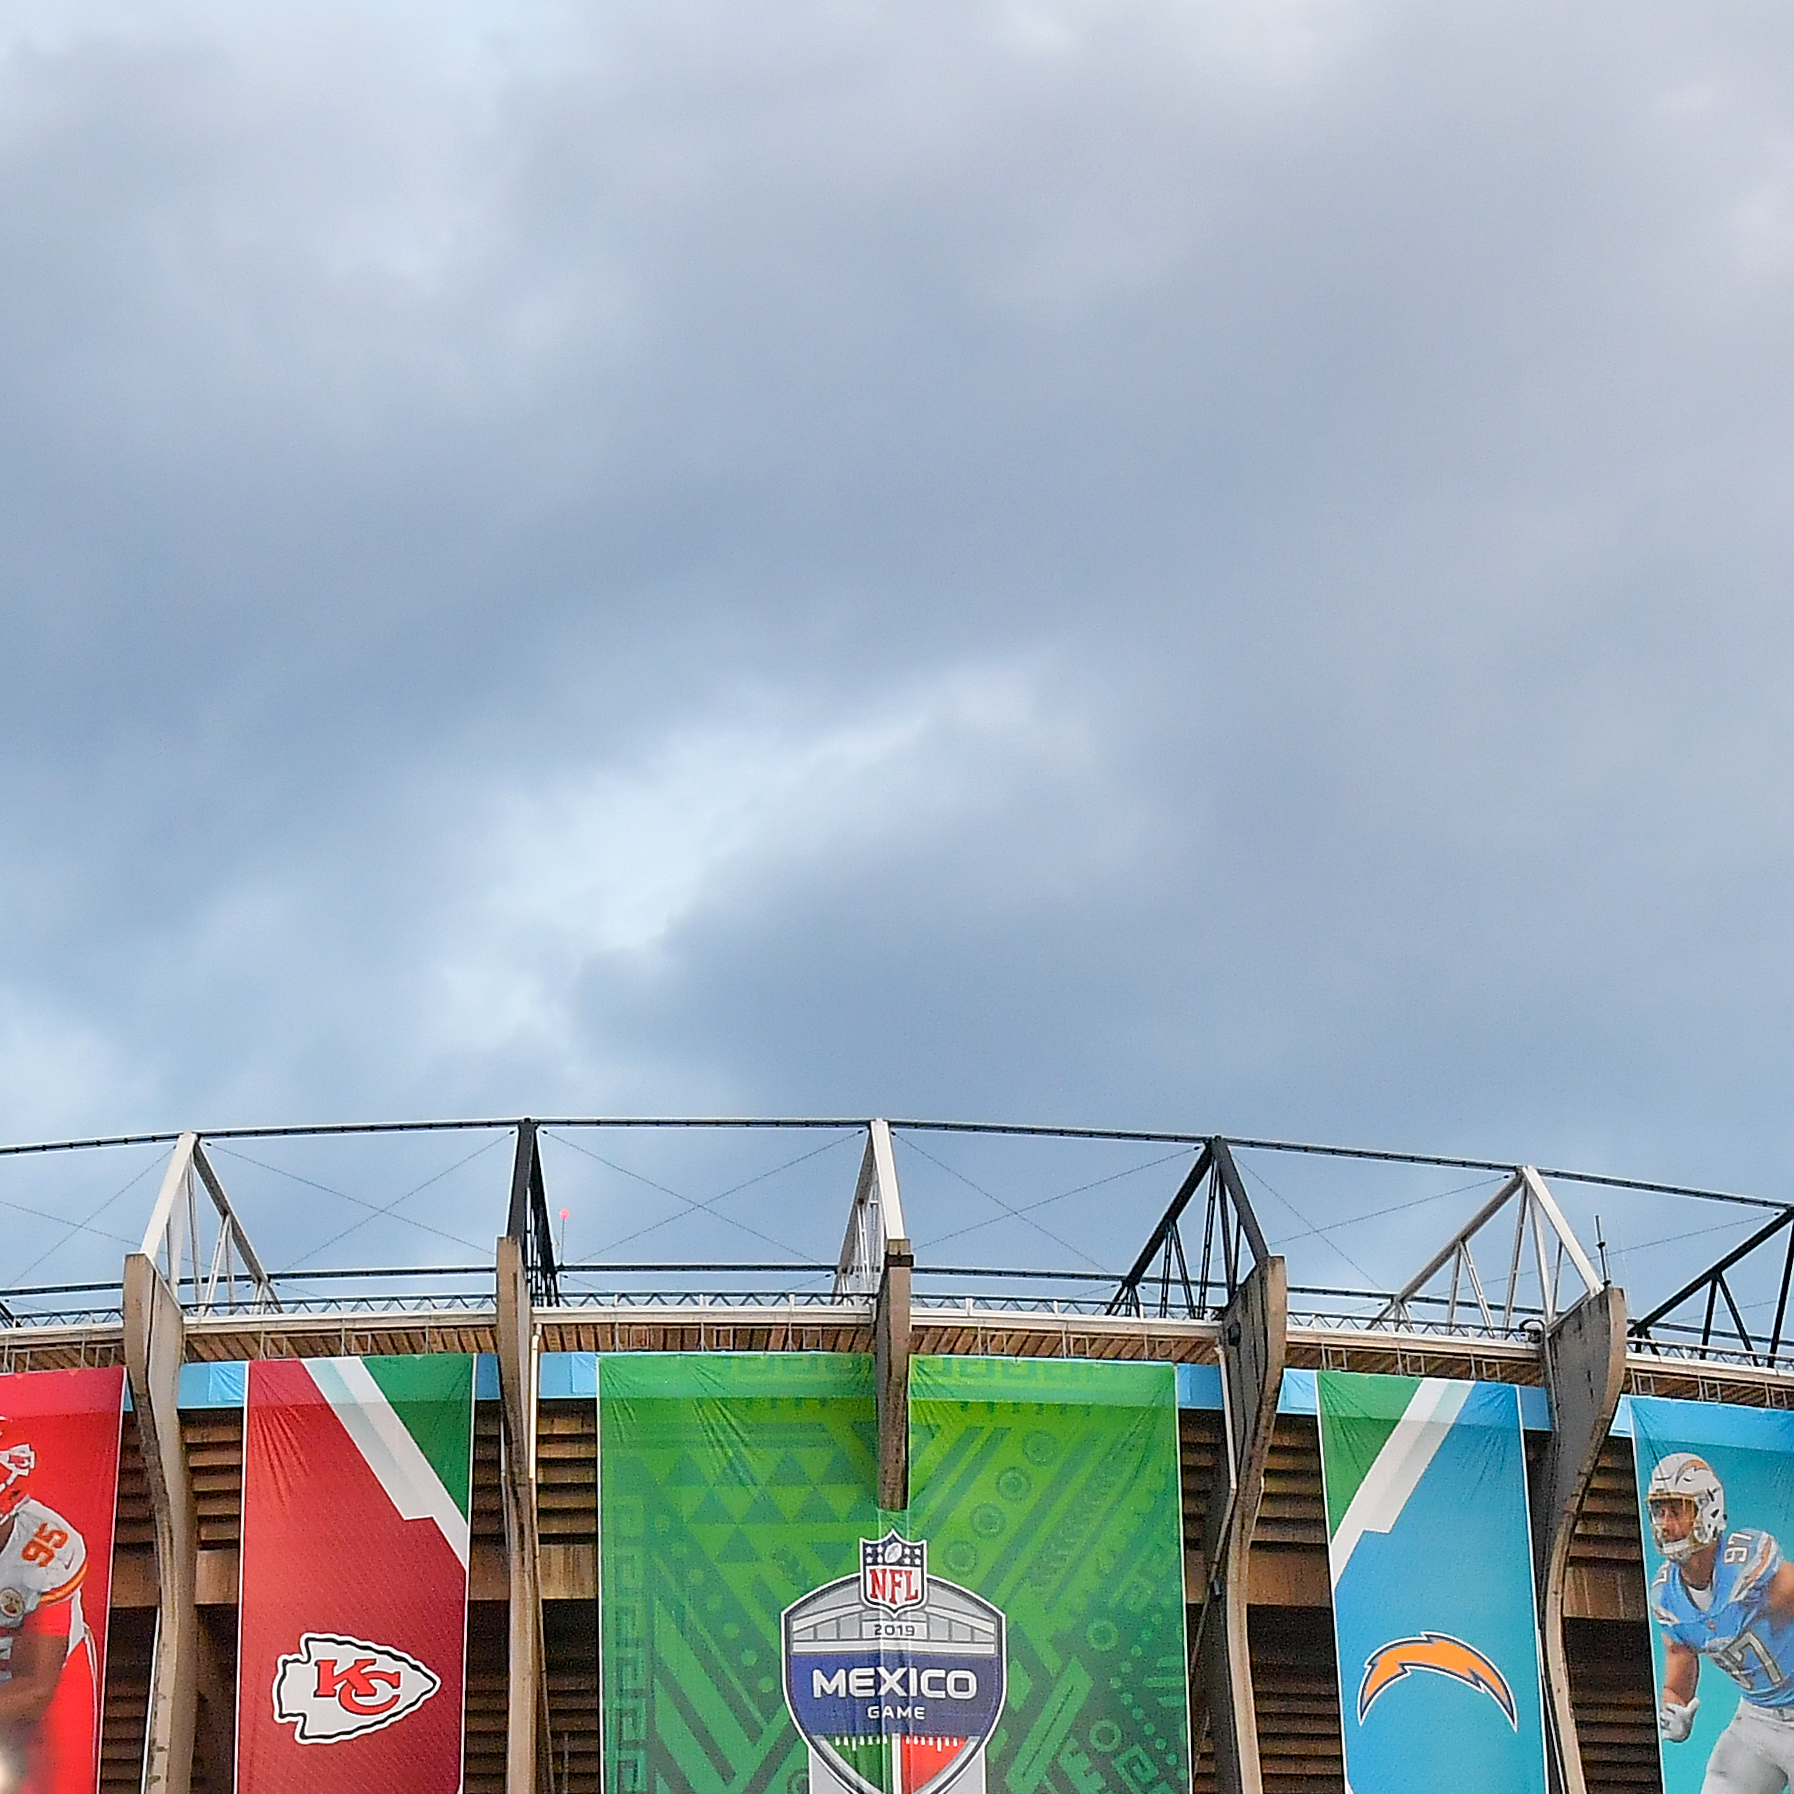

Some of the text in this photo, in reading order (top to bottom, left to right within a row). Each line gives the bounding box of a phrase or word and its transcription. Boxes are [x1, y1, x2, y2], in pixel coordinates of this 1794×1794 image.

[21, 1521, 69, 1568] 95
[1724, 1532, 1753, 1566] 97
[869, 1568, 919, 1605] NFL
[873, 1623, 915, 1637] 2019
[313, 1657, 401, 1716] KC
[812, 1666, 978, 1699] MEXICO
[867, 1705, 926, 1720] GAME
